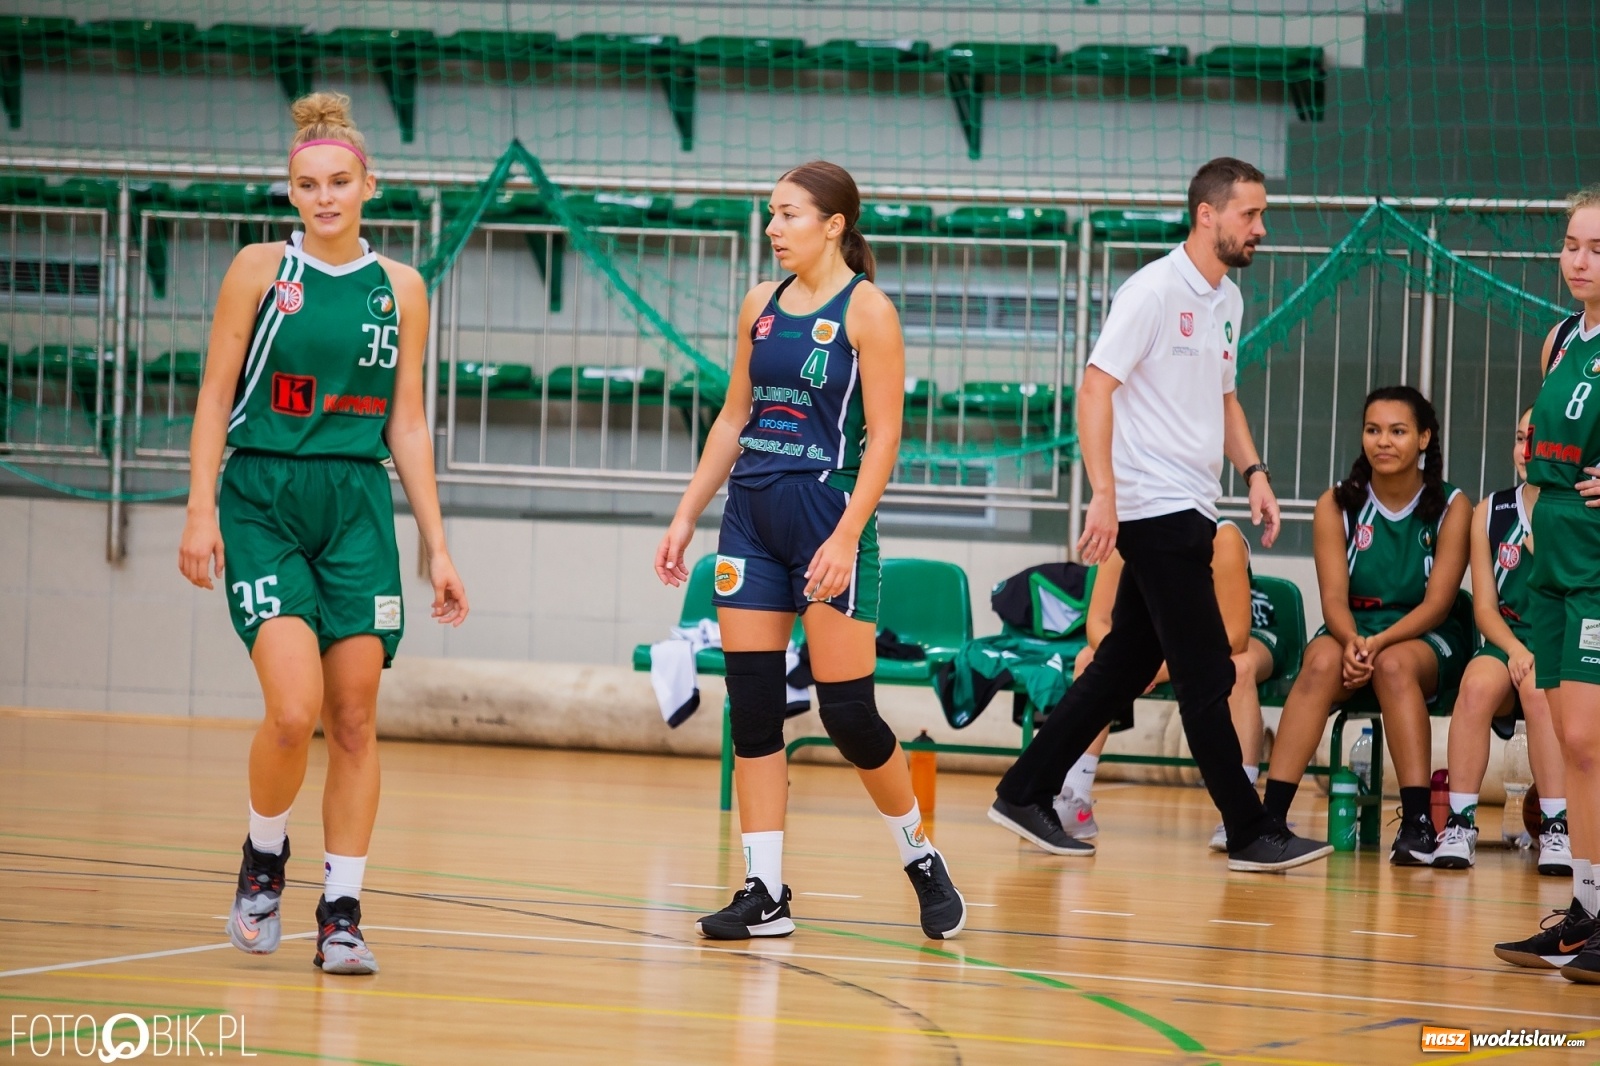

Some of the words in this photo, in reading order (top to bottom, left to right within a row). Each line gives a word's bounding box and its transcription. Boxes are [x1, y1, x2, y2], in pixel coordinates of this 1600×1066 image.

[358, 323, 399, 369] 35
[800, 347, 830, 389] 4
[276, 377, 310, 412] K
[753, 386, 812, 406] OLIMPIA
[1565, 381, 1592, 420] 8
[806, 444, 832, 462] ŚL.
[231, 574, 281, 627] 35
